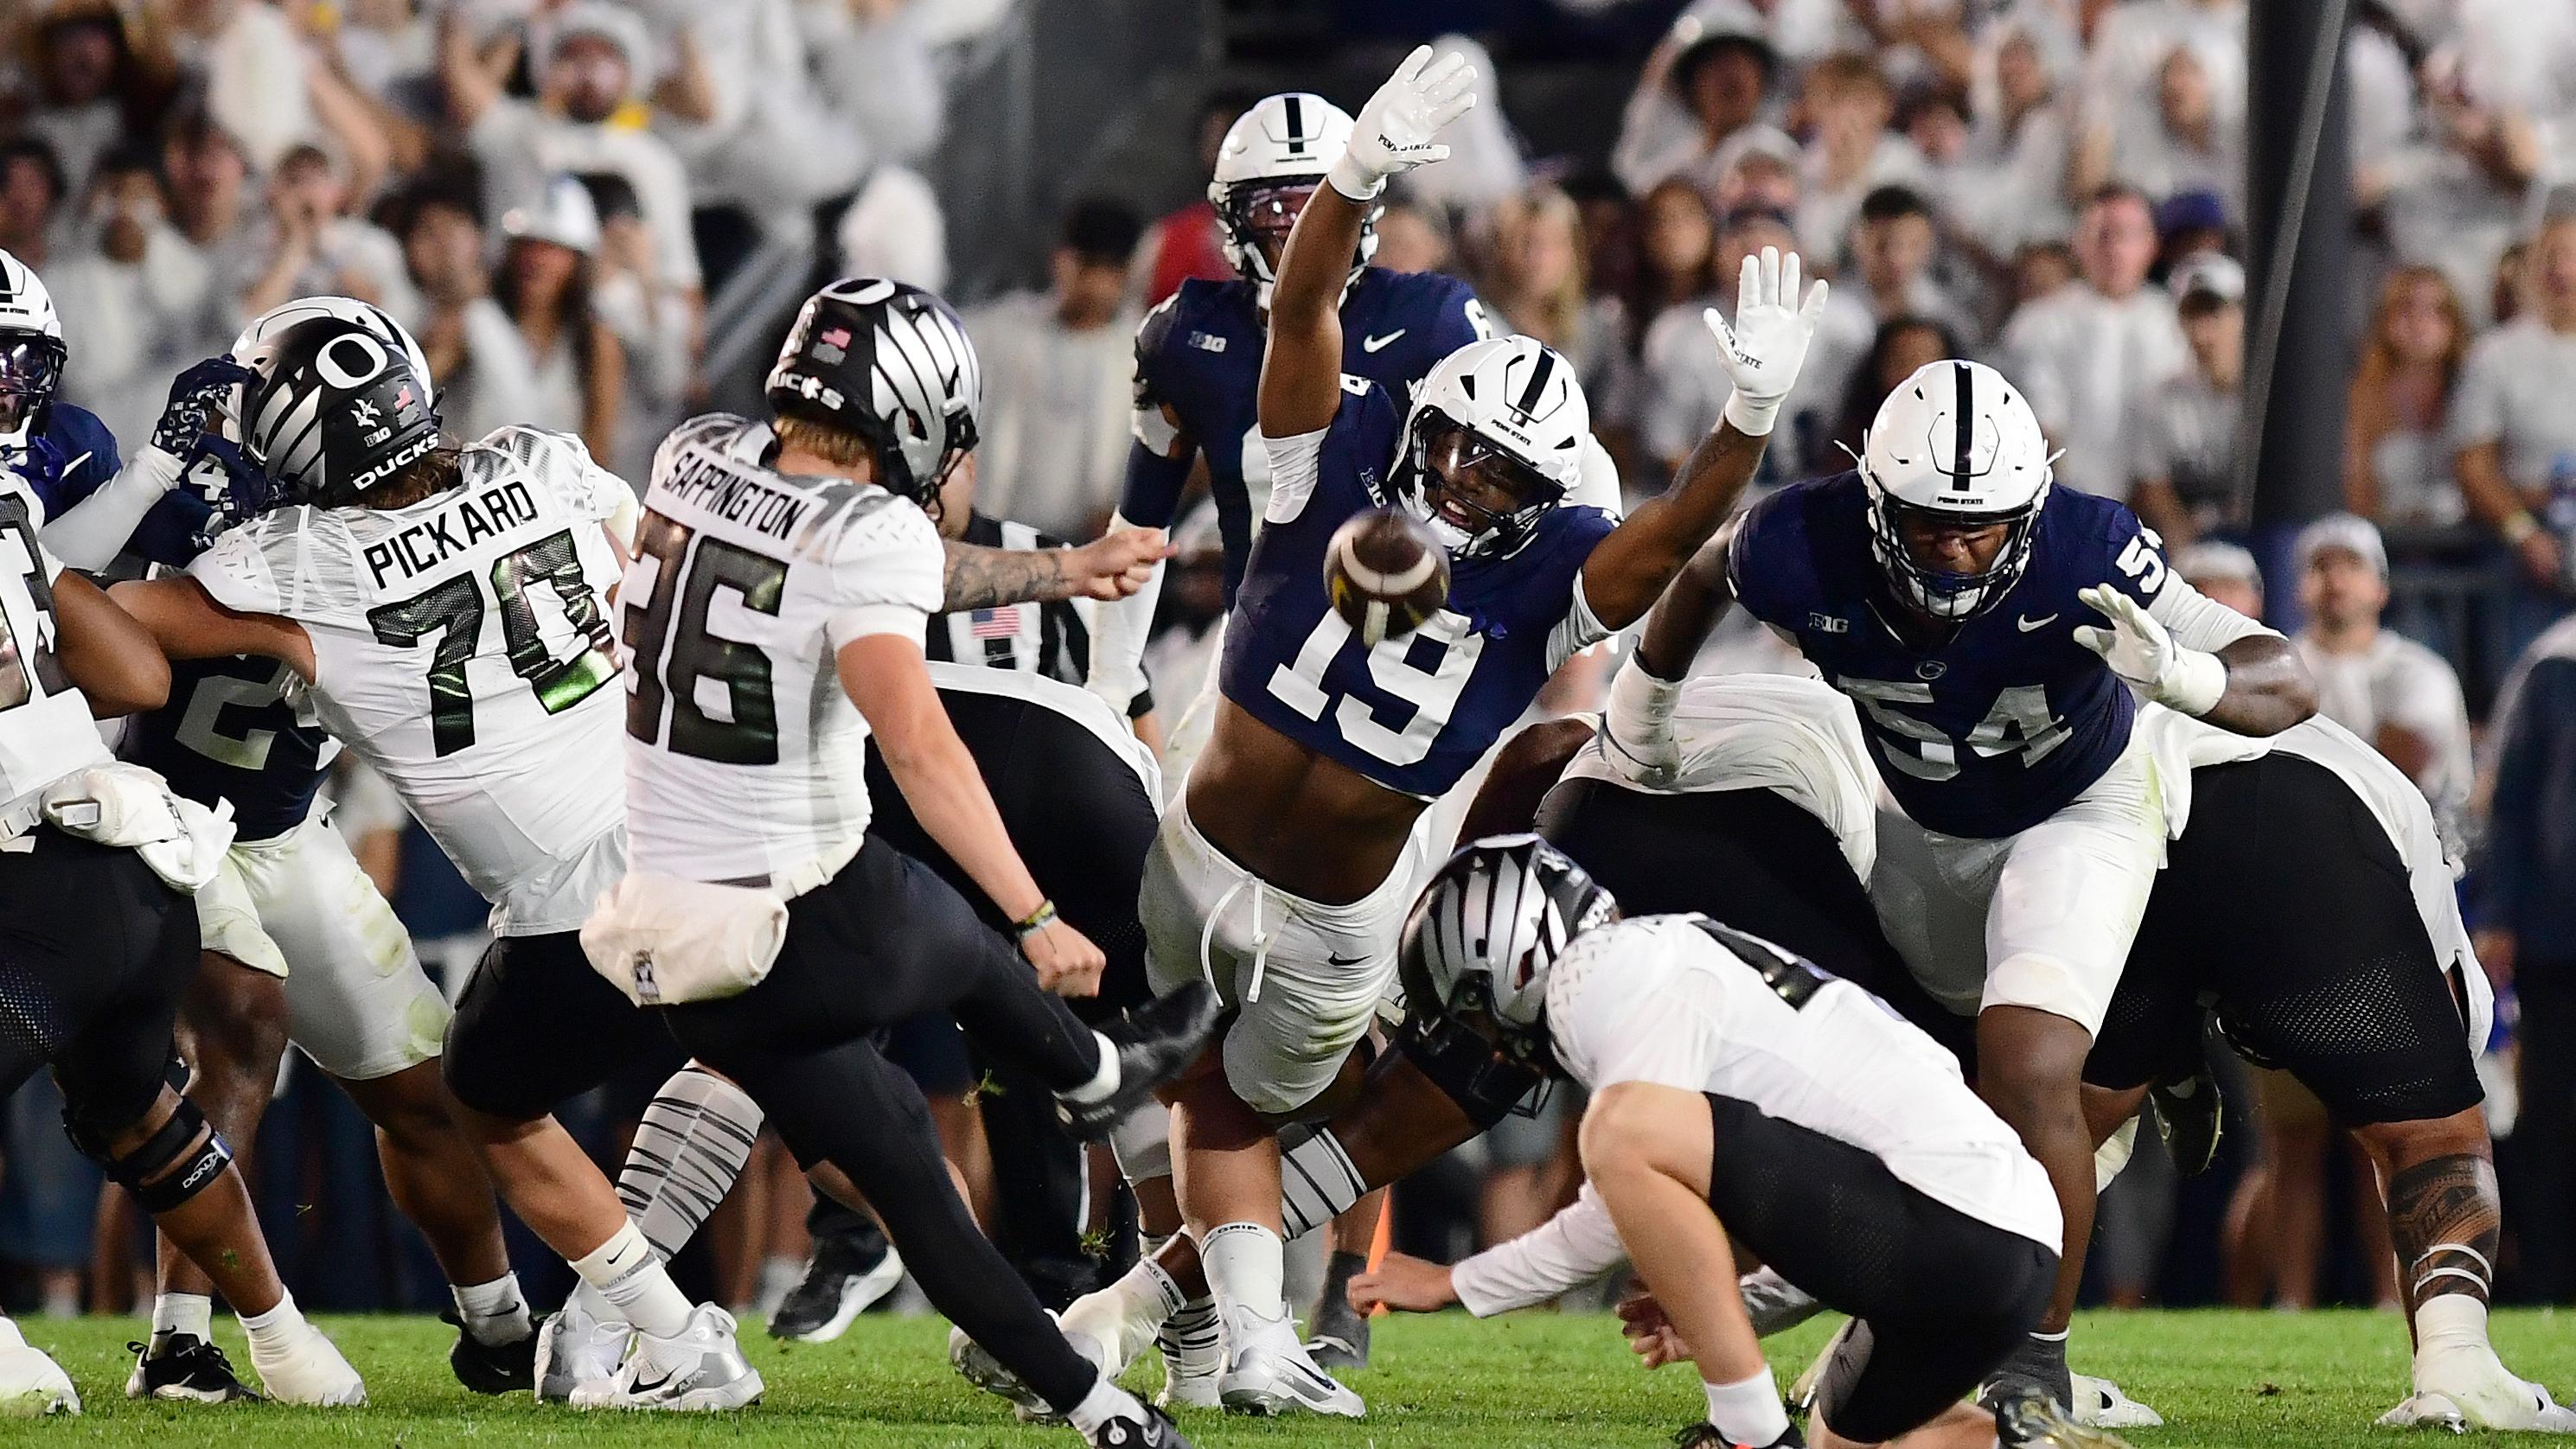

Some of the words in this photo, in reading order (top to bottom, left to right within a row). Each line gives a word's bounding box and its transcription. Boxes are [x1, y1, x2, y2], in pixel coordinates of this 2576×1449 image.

[772, 372, 846, 411] UCKS
[352, 432, 439, 491] DUCKS
[664, 450, 809, 541] SAPPINGTON
[362, 480, 539, 590] PICKARD
[2115, 527, 2166, 594] 5
[365, 527, 624, 759] 70
[1266, 605, 1486, 768] 19
[1837, 673, 2074, 782] 54
